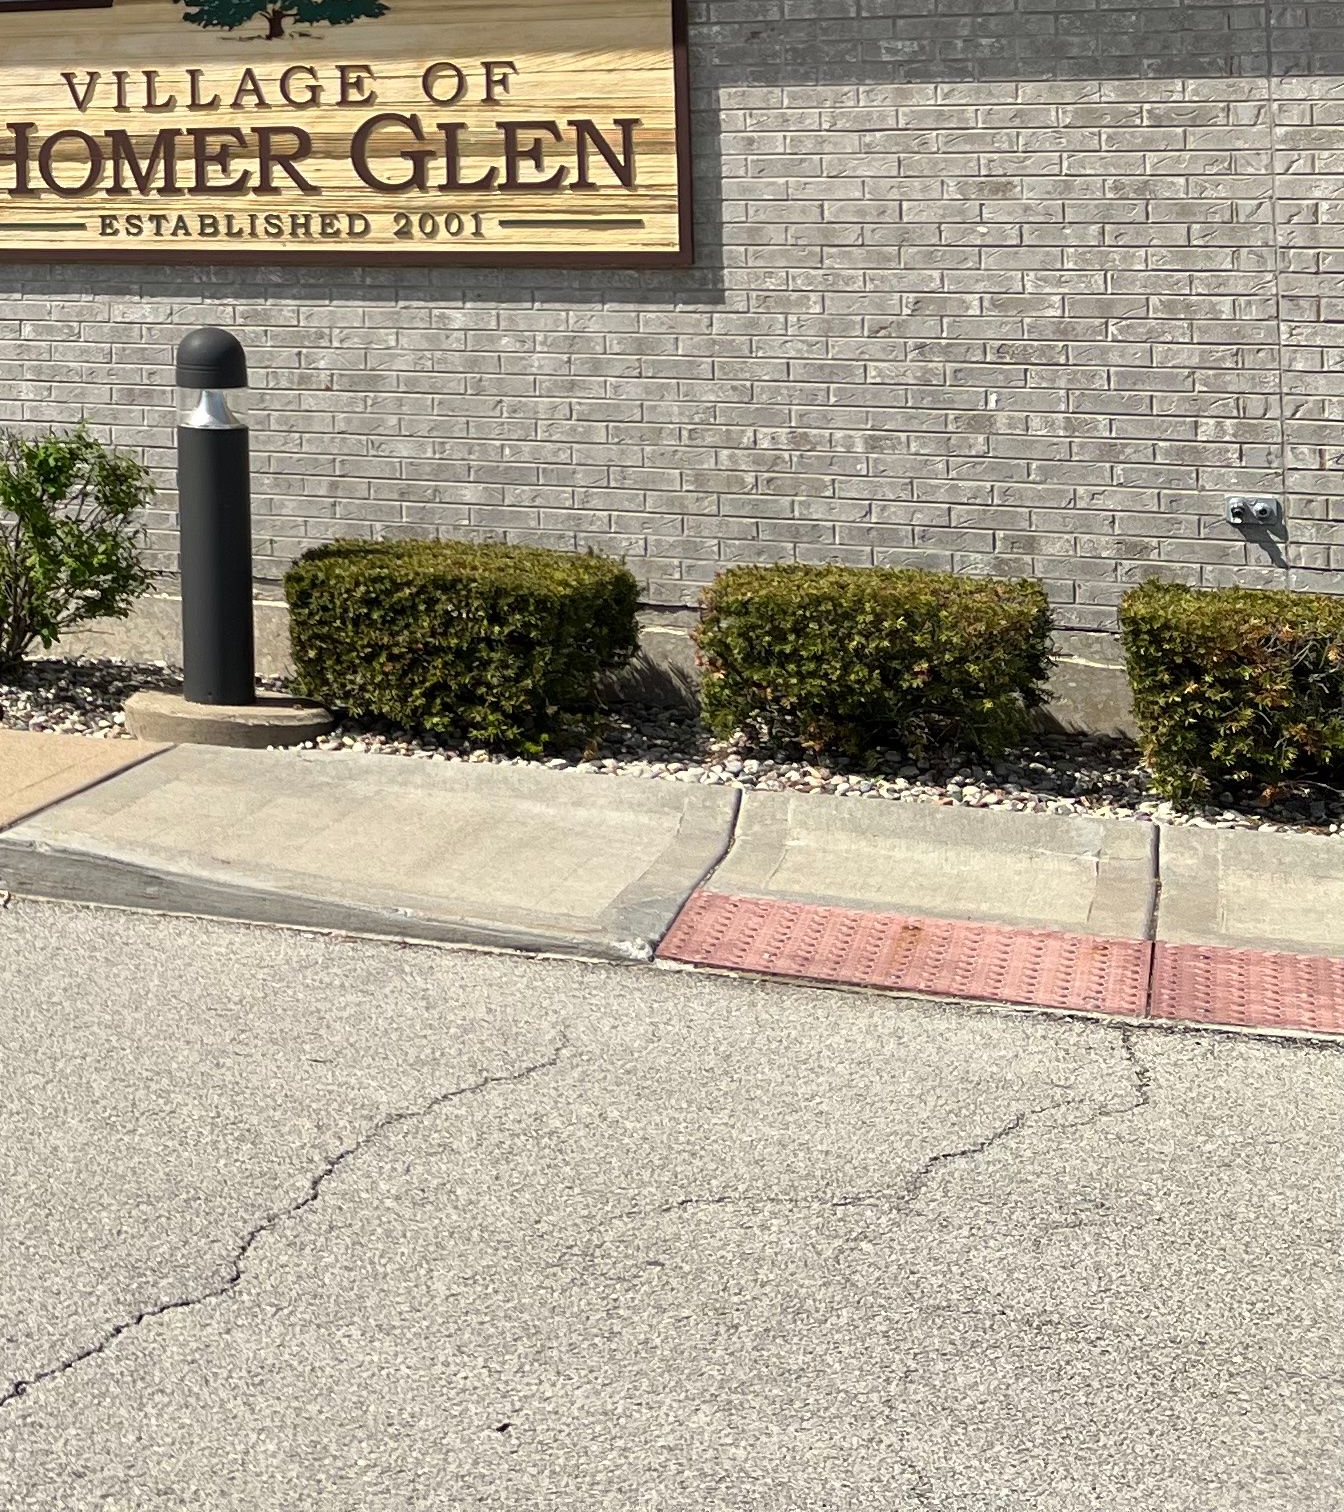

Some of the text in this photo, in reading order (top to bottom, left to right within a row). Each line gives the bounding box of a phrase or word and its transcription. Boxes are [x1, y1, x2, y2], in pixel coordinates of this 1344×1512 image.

[60, 60, 520, 113] VILLAGE OF
[350, 112, 644, 194] GLEN
[98, 211, 487, 239] ESTABLISHED 2001
